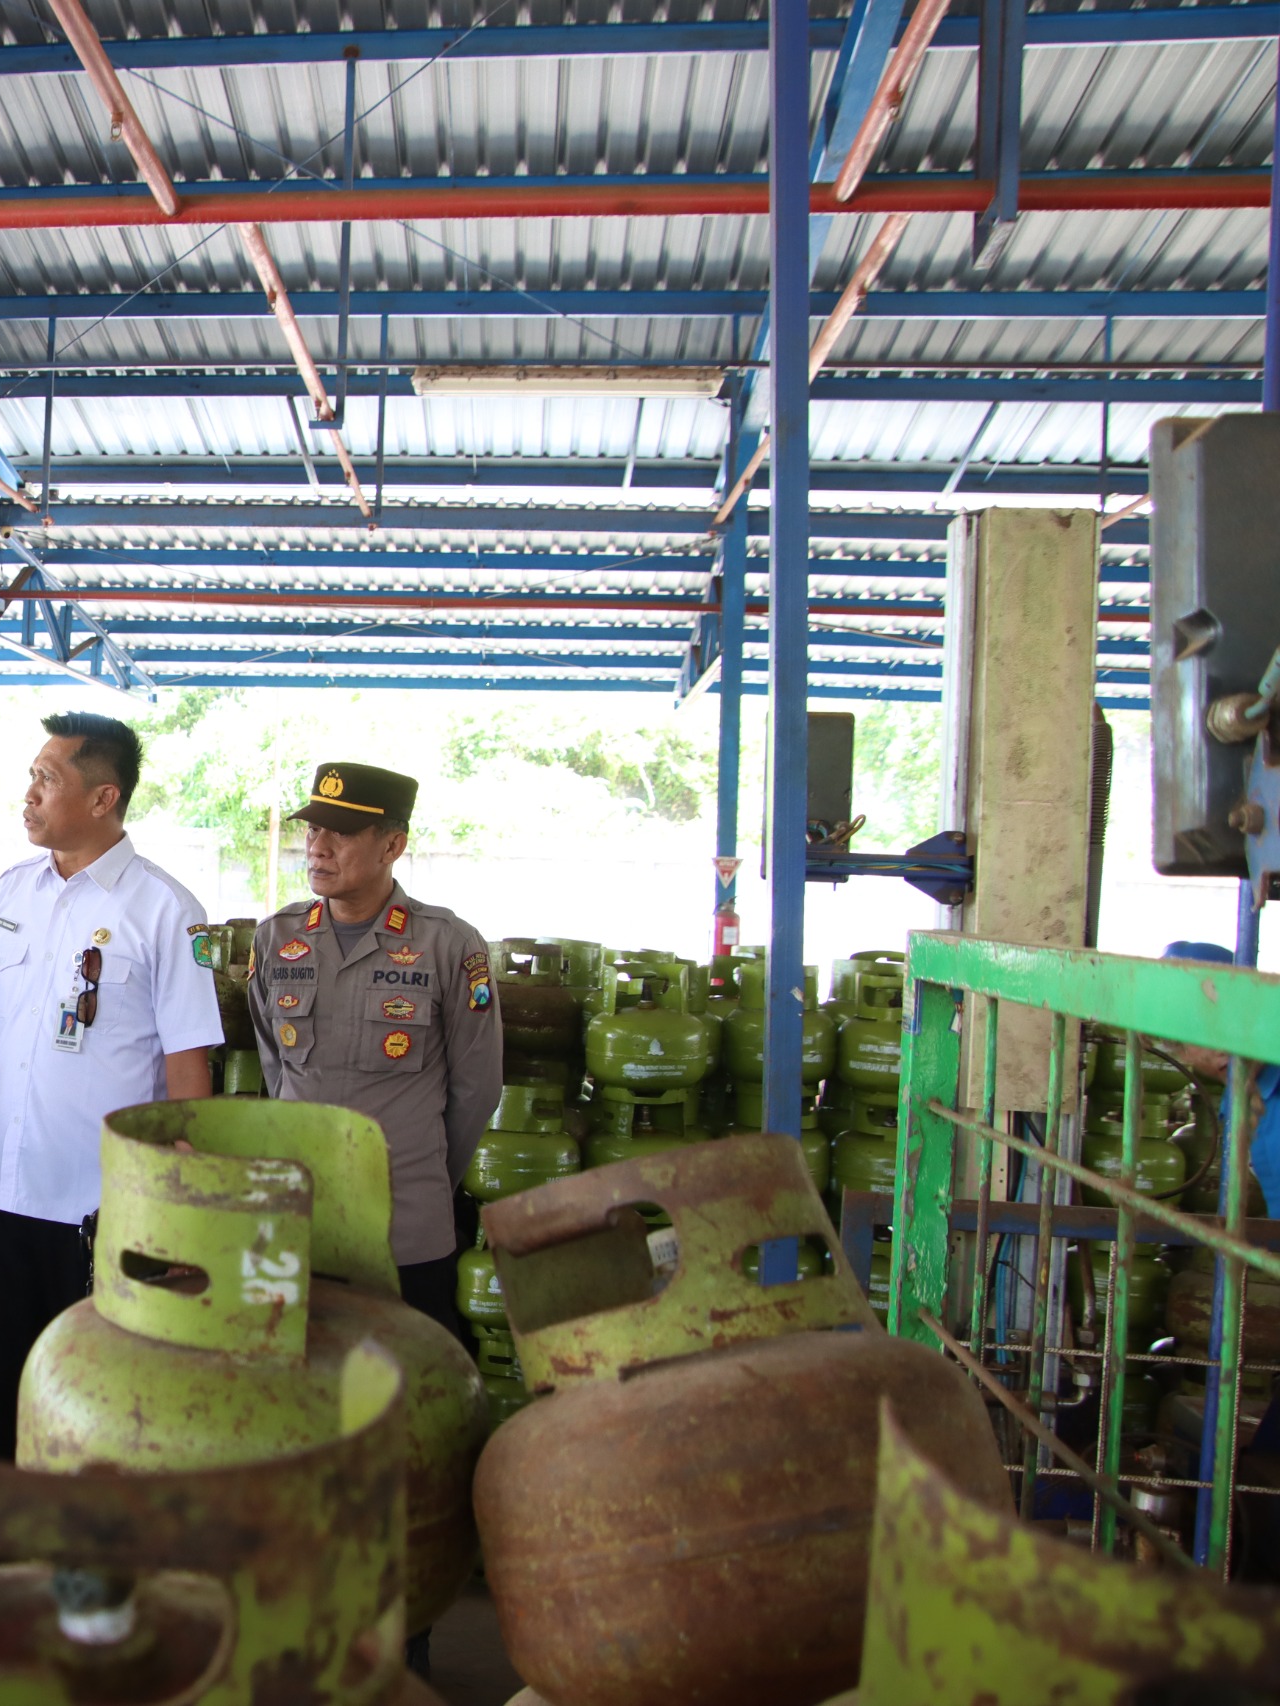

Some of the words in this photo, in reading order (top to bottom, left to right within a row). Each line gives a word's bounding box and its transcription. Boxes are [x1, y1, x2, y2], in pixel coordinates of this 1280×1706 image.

[272, 966, 289, 980] AGUS
[290, 966, 315, 980] SUGITO
[372, 970, 429, 988] POLRI
